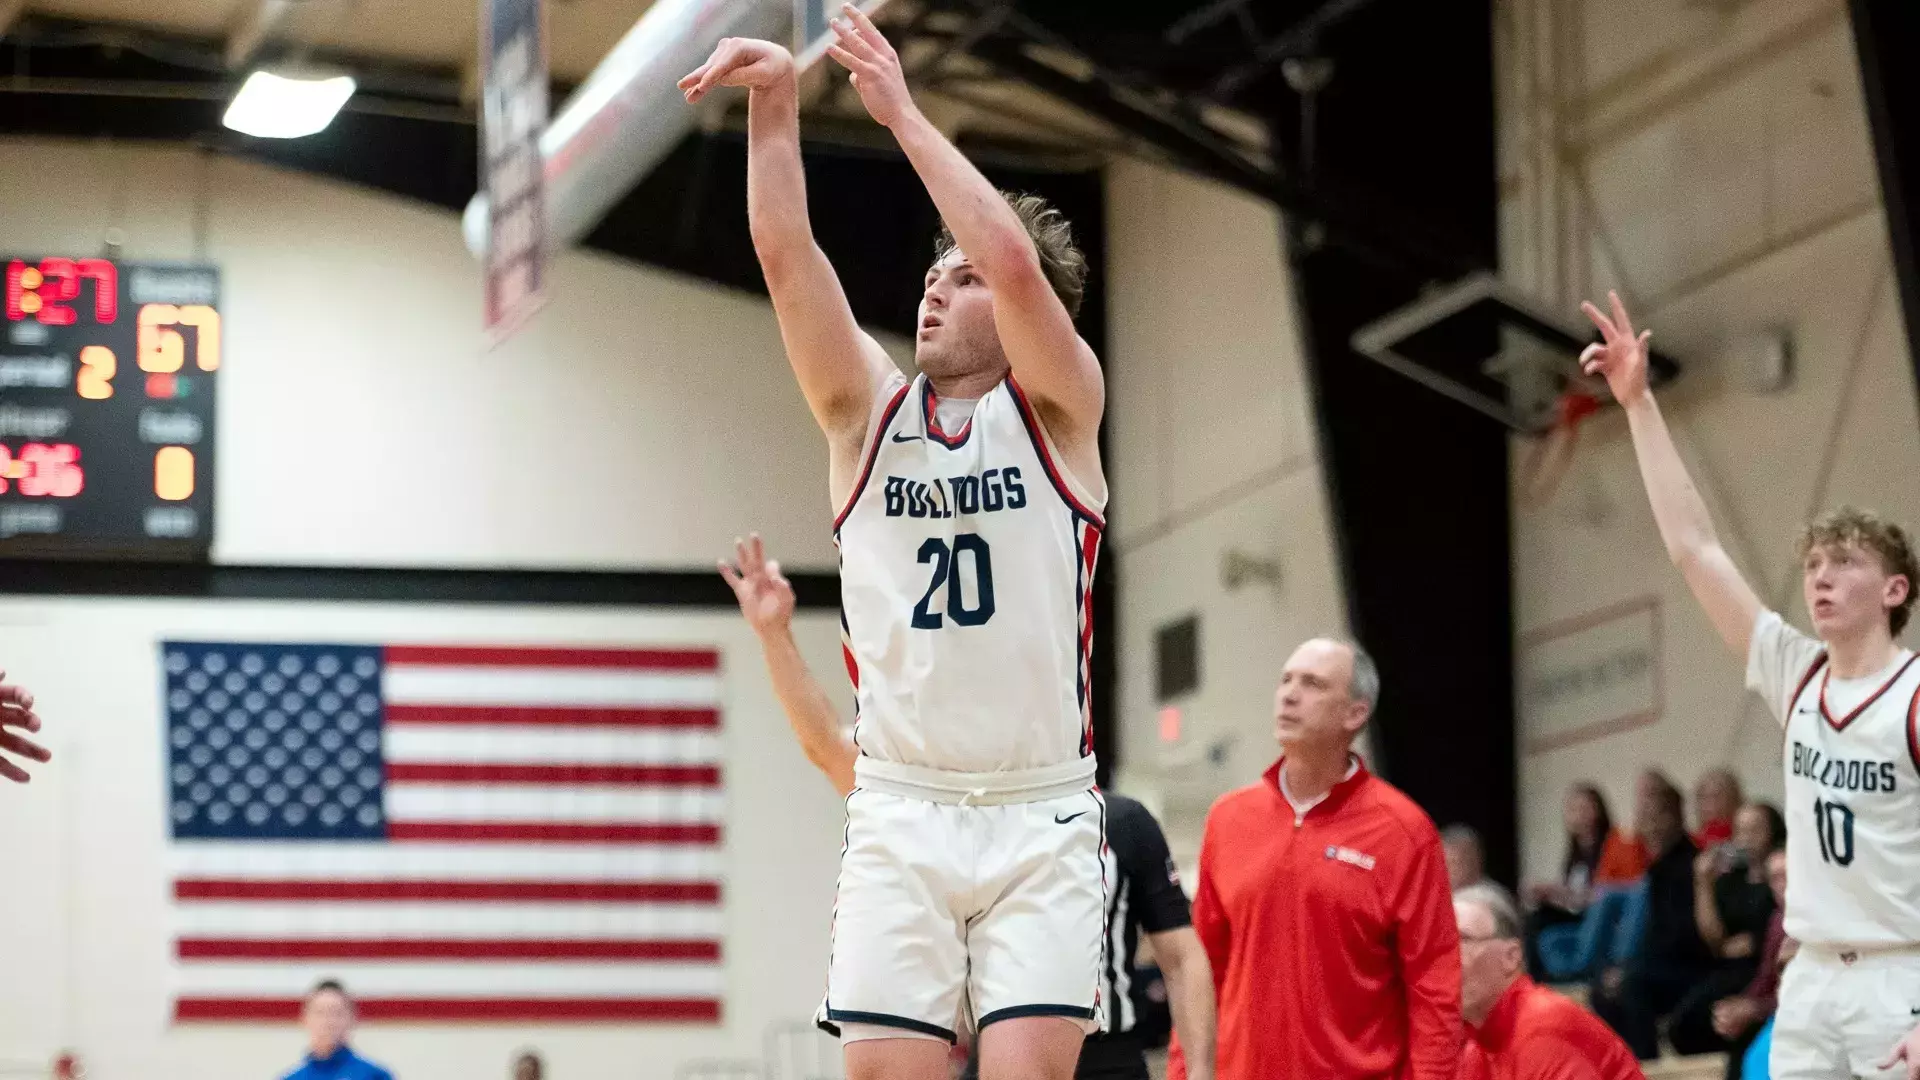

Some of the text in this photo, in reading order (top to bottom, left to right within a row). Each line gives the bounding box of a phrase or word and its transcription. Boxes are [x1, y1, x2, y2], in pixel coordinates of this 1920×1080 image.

[6, 257, 118, 325] 1:27
[136, 303, 222, 373] 67
[76, 345, 118, 400] 2
[154, 446, 195, 500] 0
[910, 533, 996, 630] 20
[1793, 741, 1897, 792] BULLDOGS
[1814, 797, 1855, 868] 10
